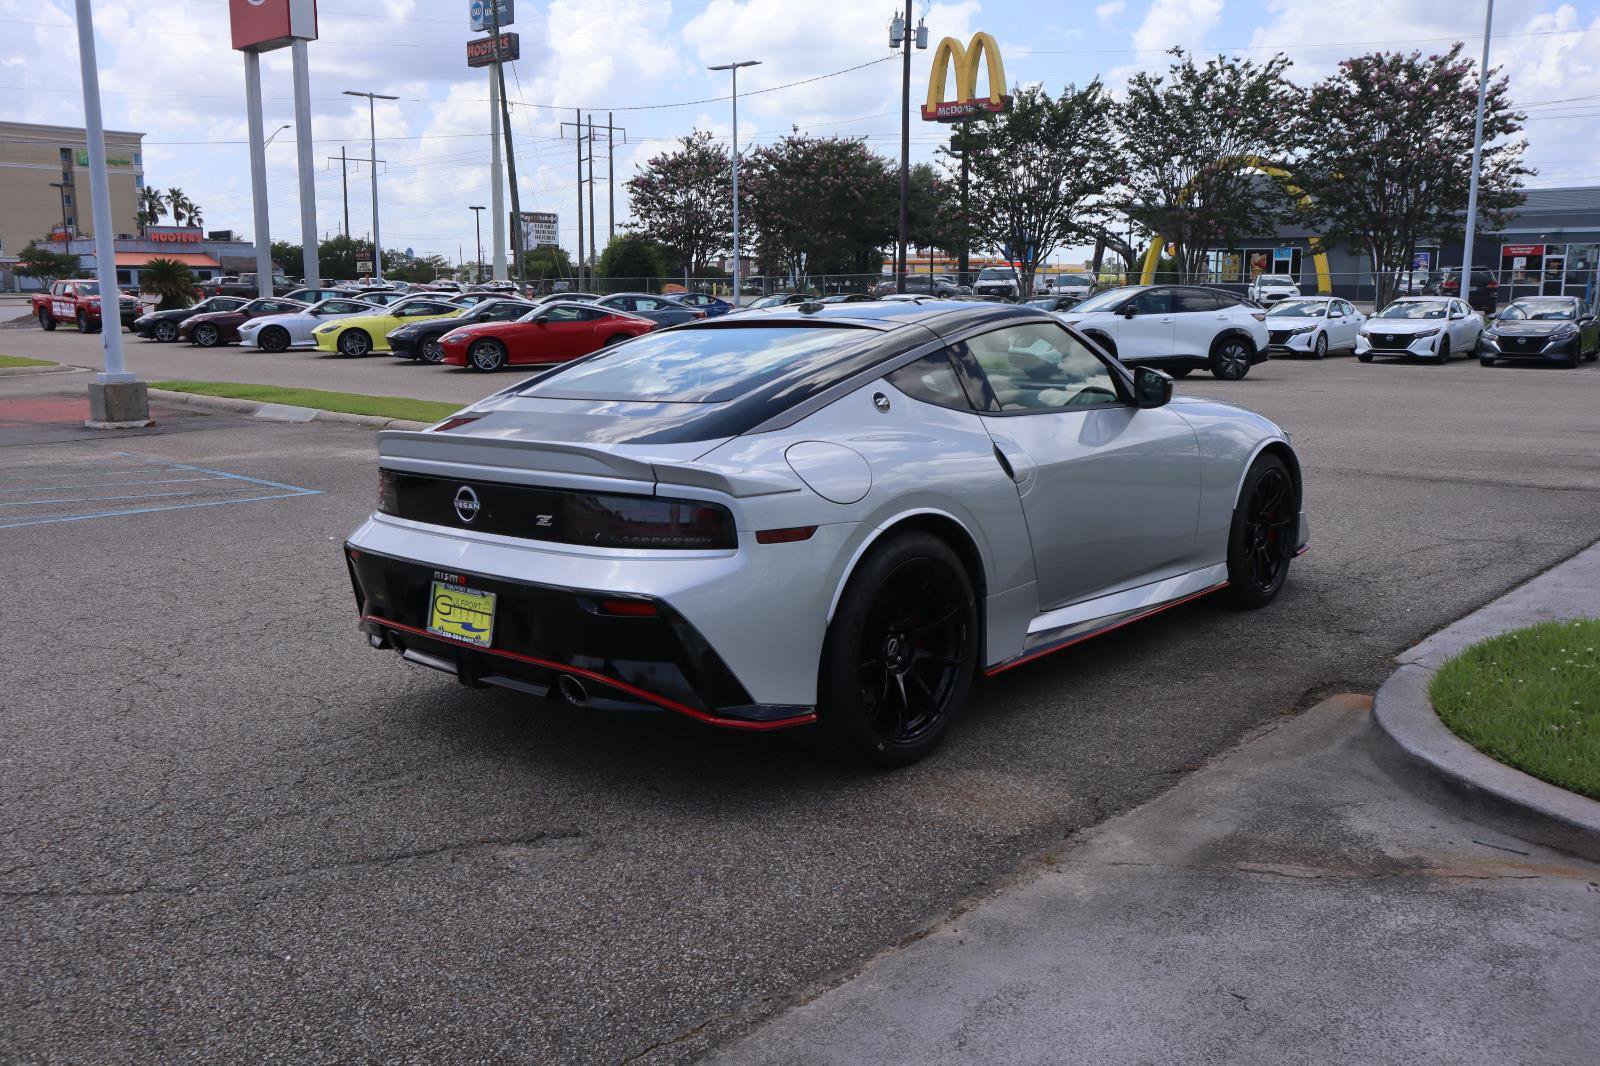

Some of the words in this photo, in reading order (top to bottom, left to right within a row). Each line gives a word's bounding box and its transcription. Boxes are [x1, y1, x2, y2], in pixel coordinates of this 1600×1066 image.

[151, 231, 203, 243] HOOTERS
[453, 500, 480, 510] NISSAN
[536, 514, 553, 527] Z
